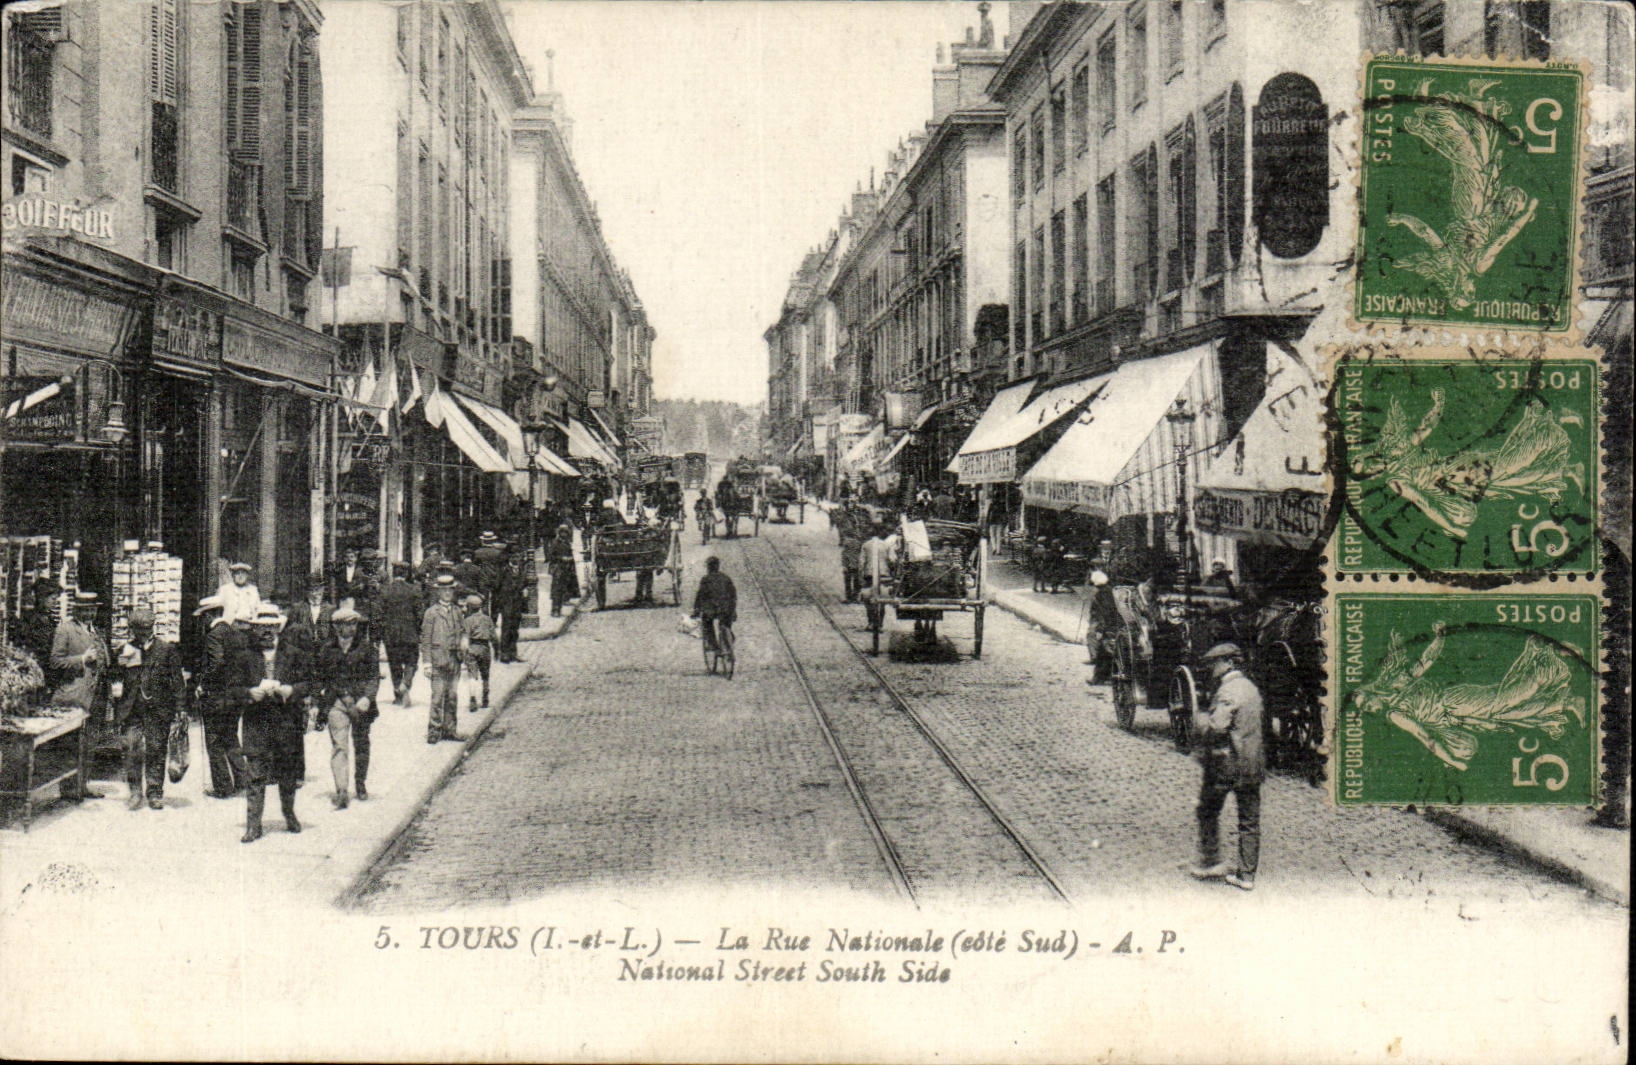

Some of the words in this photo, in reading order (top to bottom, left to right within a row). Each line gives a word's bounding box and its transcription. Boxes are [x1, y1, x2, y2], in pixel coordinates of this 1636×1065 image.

[1373, 79, 1396, 164] POSTES
[1364, 294, 1446, 316] FRANÇAISE
[1473, 300, 1561, 322] REPUBLIQUE
[1496, 370, 1581, 390] POSTES
[1496, 603, 1581, 623] POSTES
[1344, 603, 1364, 683] FRANÇAISE
[1344, 711, 1363, 800] REPUBLIQUE
